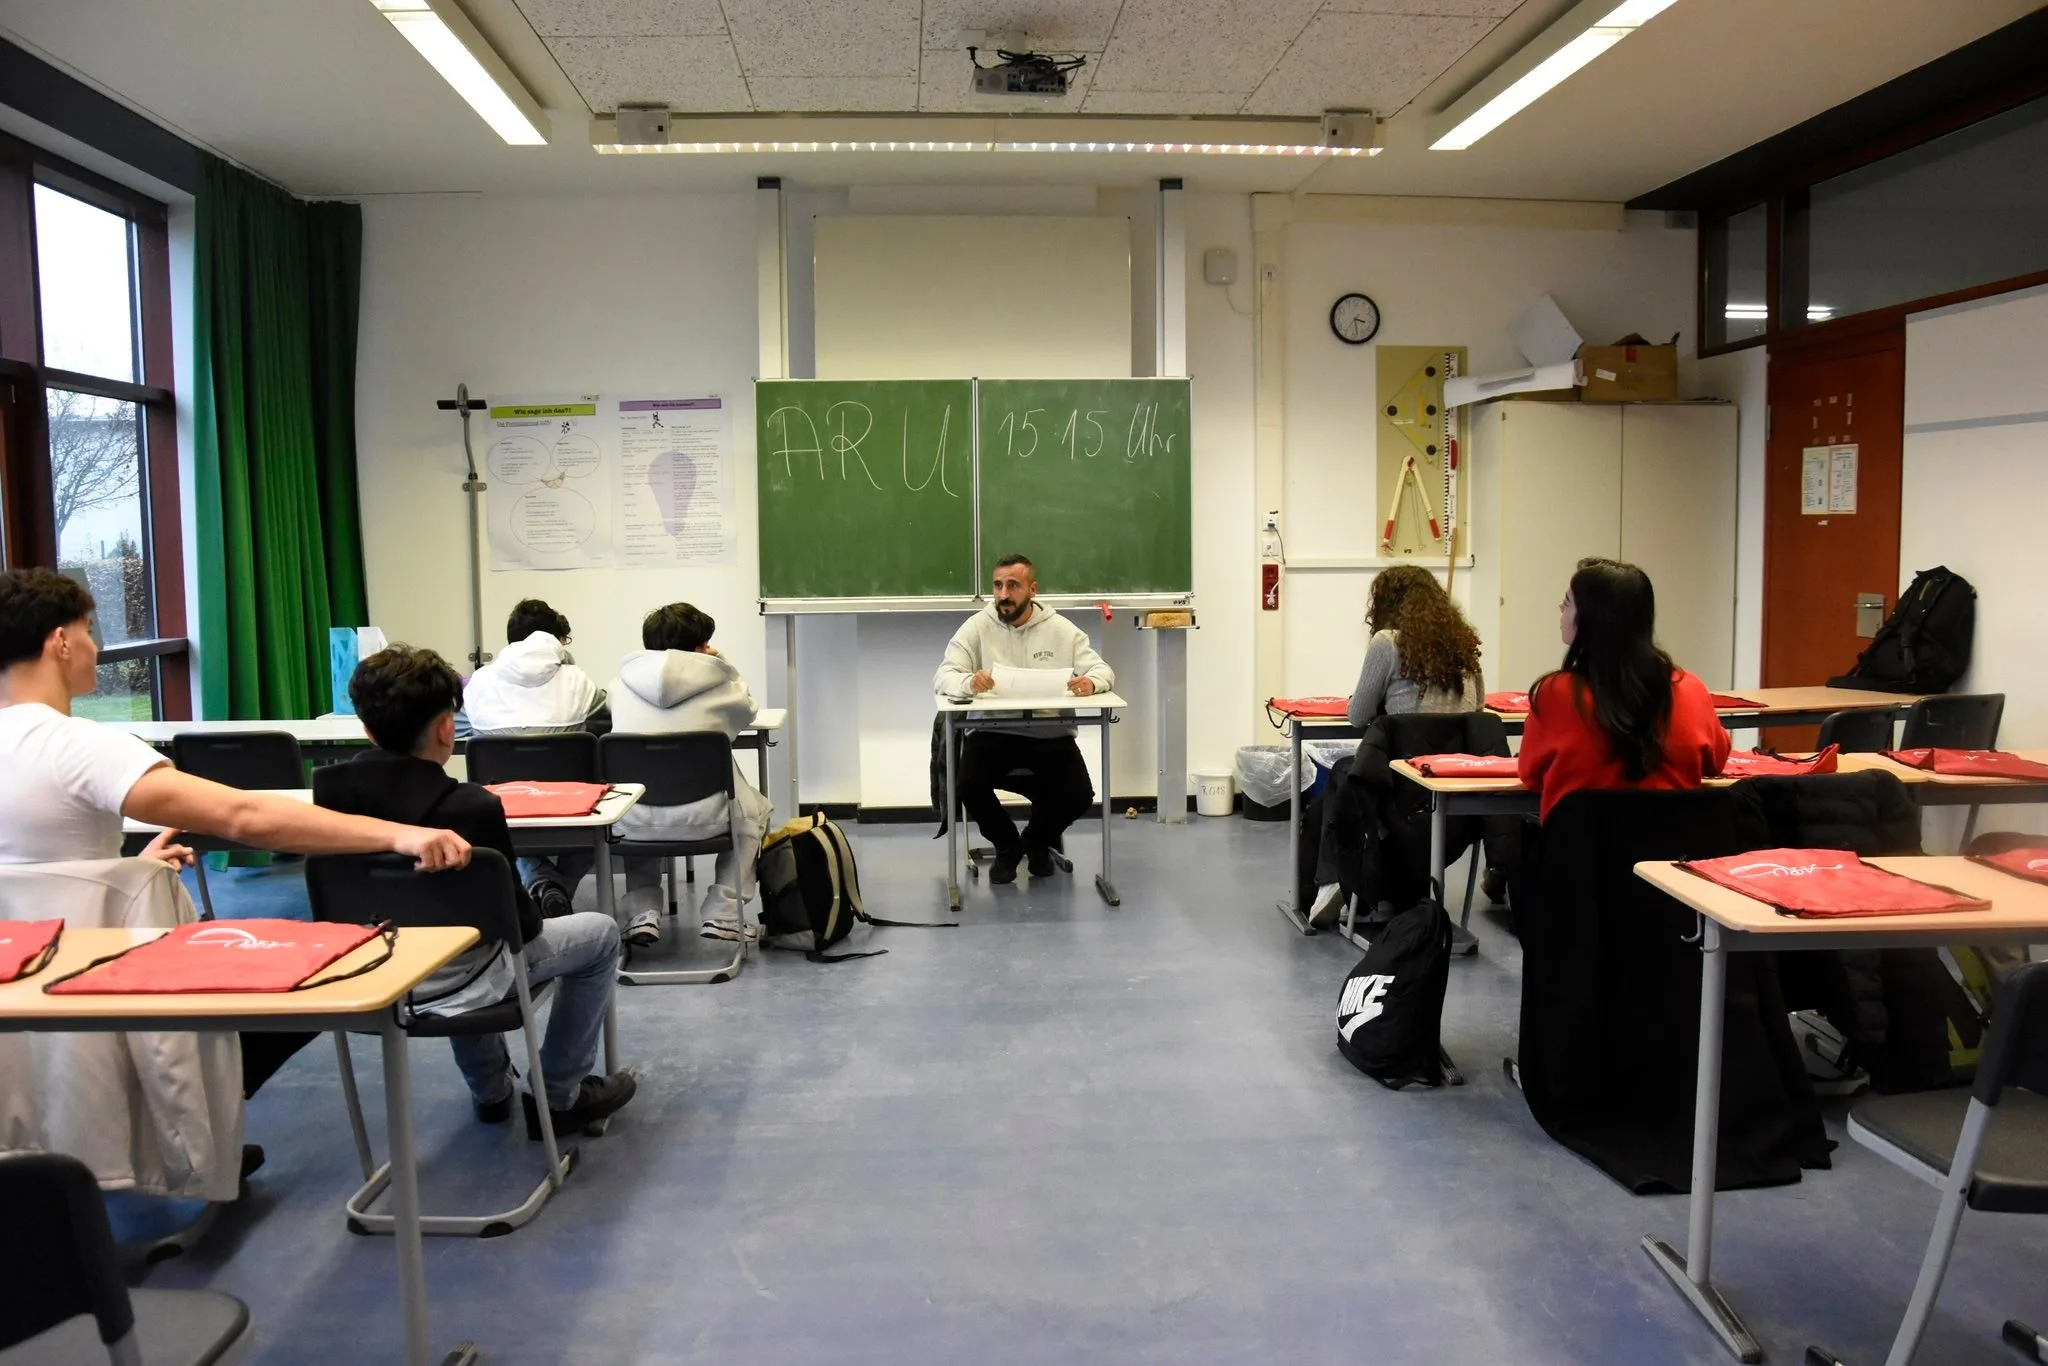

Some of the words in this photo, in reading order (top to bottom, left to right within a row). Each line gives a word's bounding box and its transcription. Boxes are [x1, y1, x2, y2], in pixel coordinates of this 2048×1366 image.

[767, 400, 960, 498] ARU
[1126, 402, 1177, 459] Uhr
[1337, 974, 1395, 1018] NIKE
